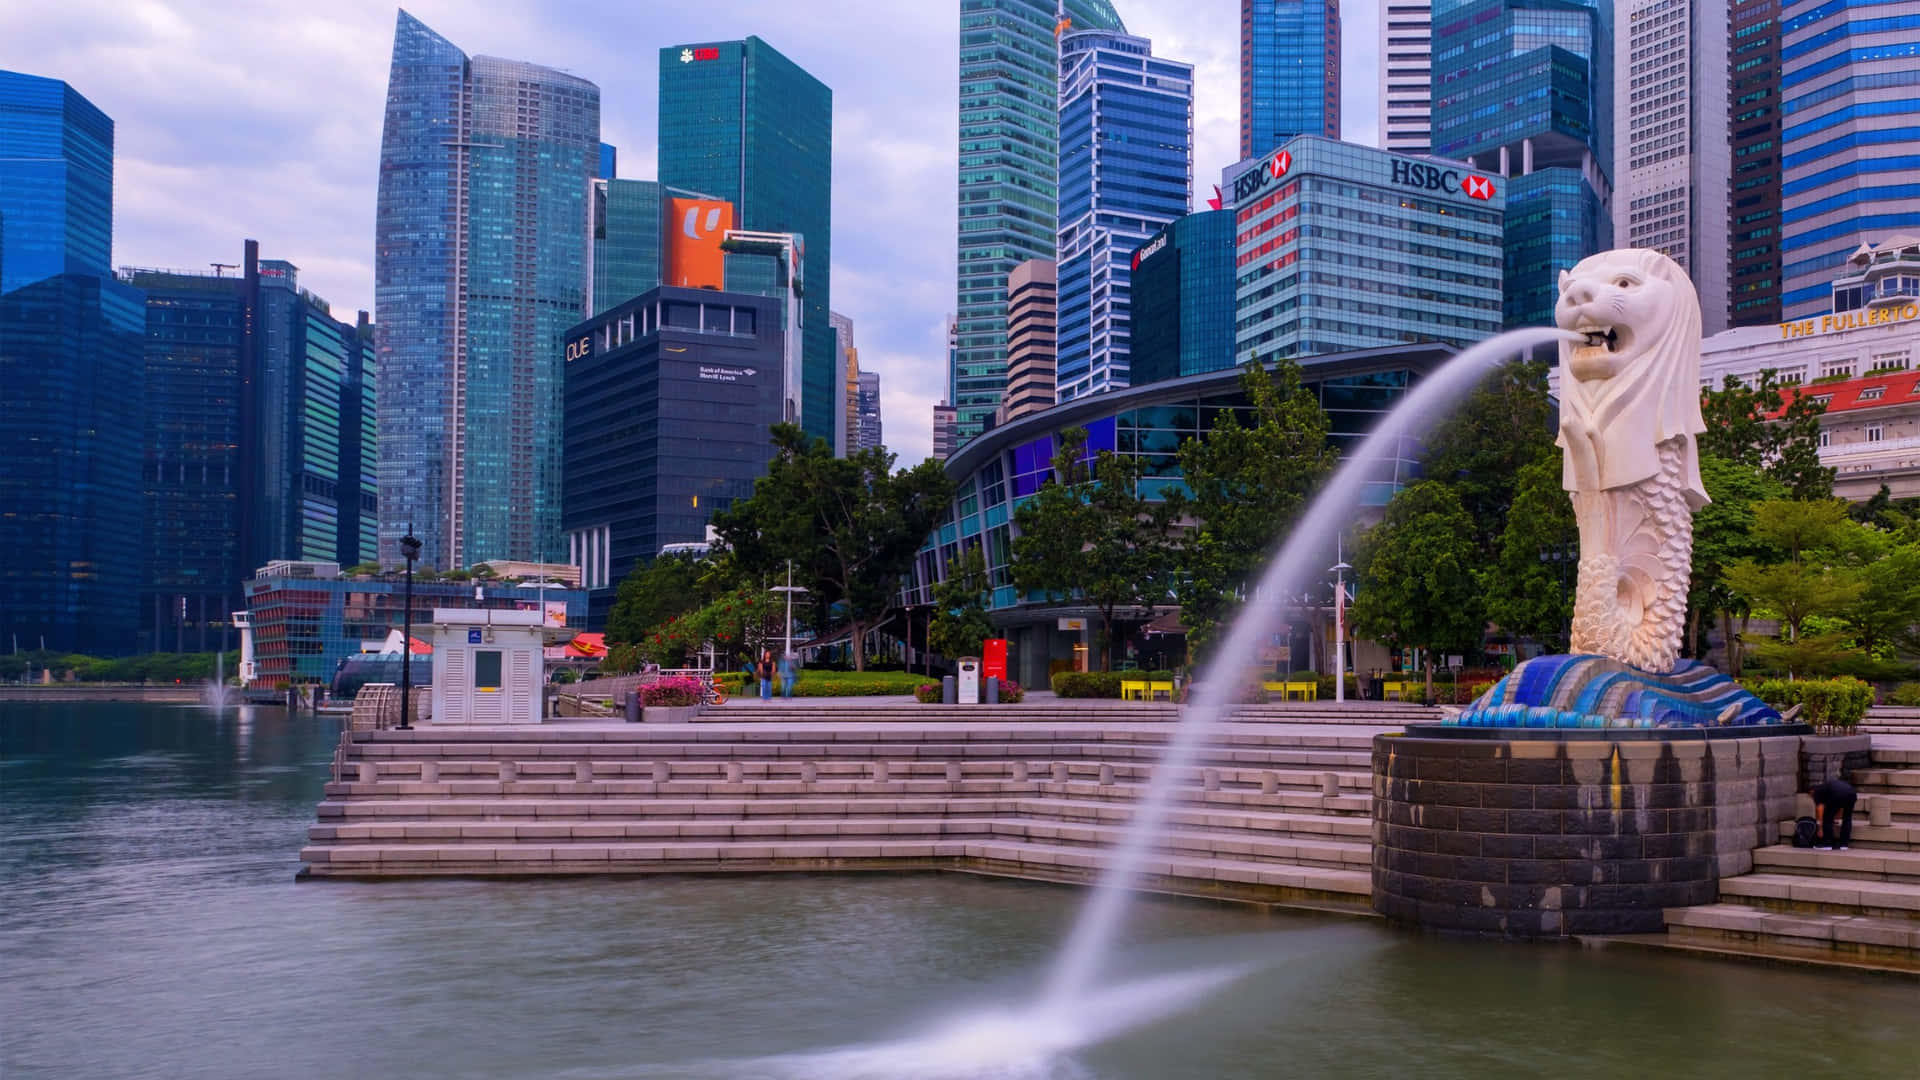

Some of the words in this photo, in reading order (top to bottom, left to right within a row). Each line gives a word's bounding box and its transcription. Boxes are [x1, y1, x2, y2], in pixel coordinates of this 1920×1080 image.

[694, 47, 720, 61] UBS
[1233, 160, 1271, 204] HSBC
[1391, 158, 1459, 194] HSBC
[1779, 319, 1815, 339] THE
[566, 336, 590, 362] OUE
